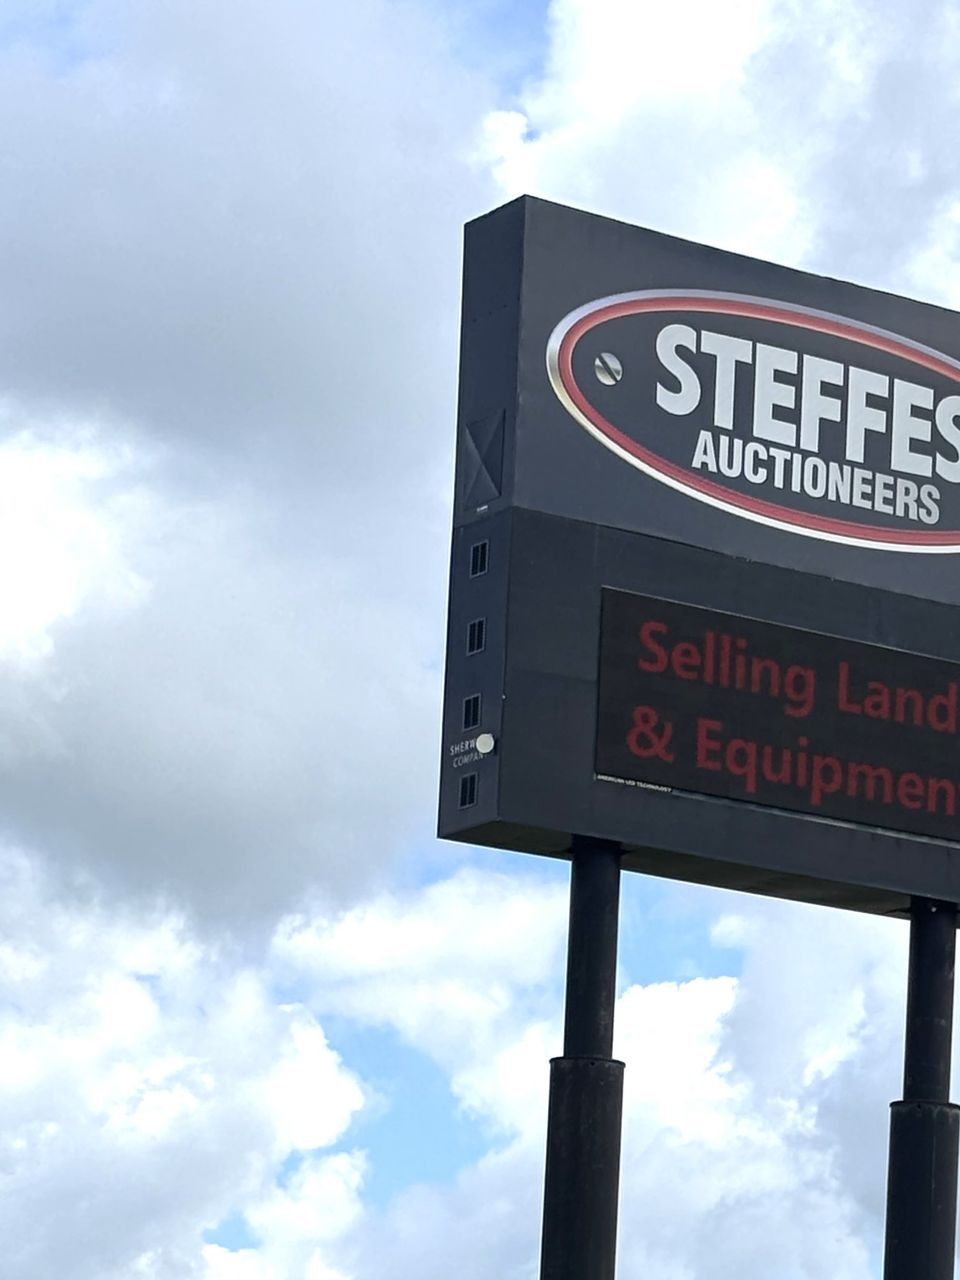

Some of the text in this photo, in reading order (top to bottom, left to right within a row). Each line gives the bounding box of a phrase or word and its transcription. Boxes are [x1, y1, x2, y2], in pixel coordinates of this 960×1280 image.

[691, 429, 941, 525] AUCTIONEERS
[637, 620, 959, 735] Selling Land
[452, 751, 486, 768] COMPAN
[626, 704, 675, 764] &
